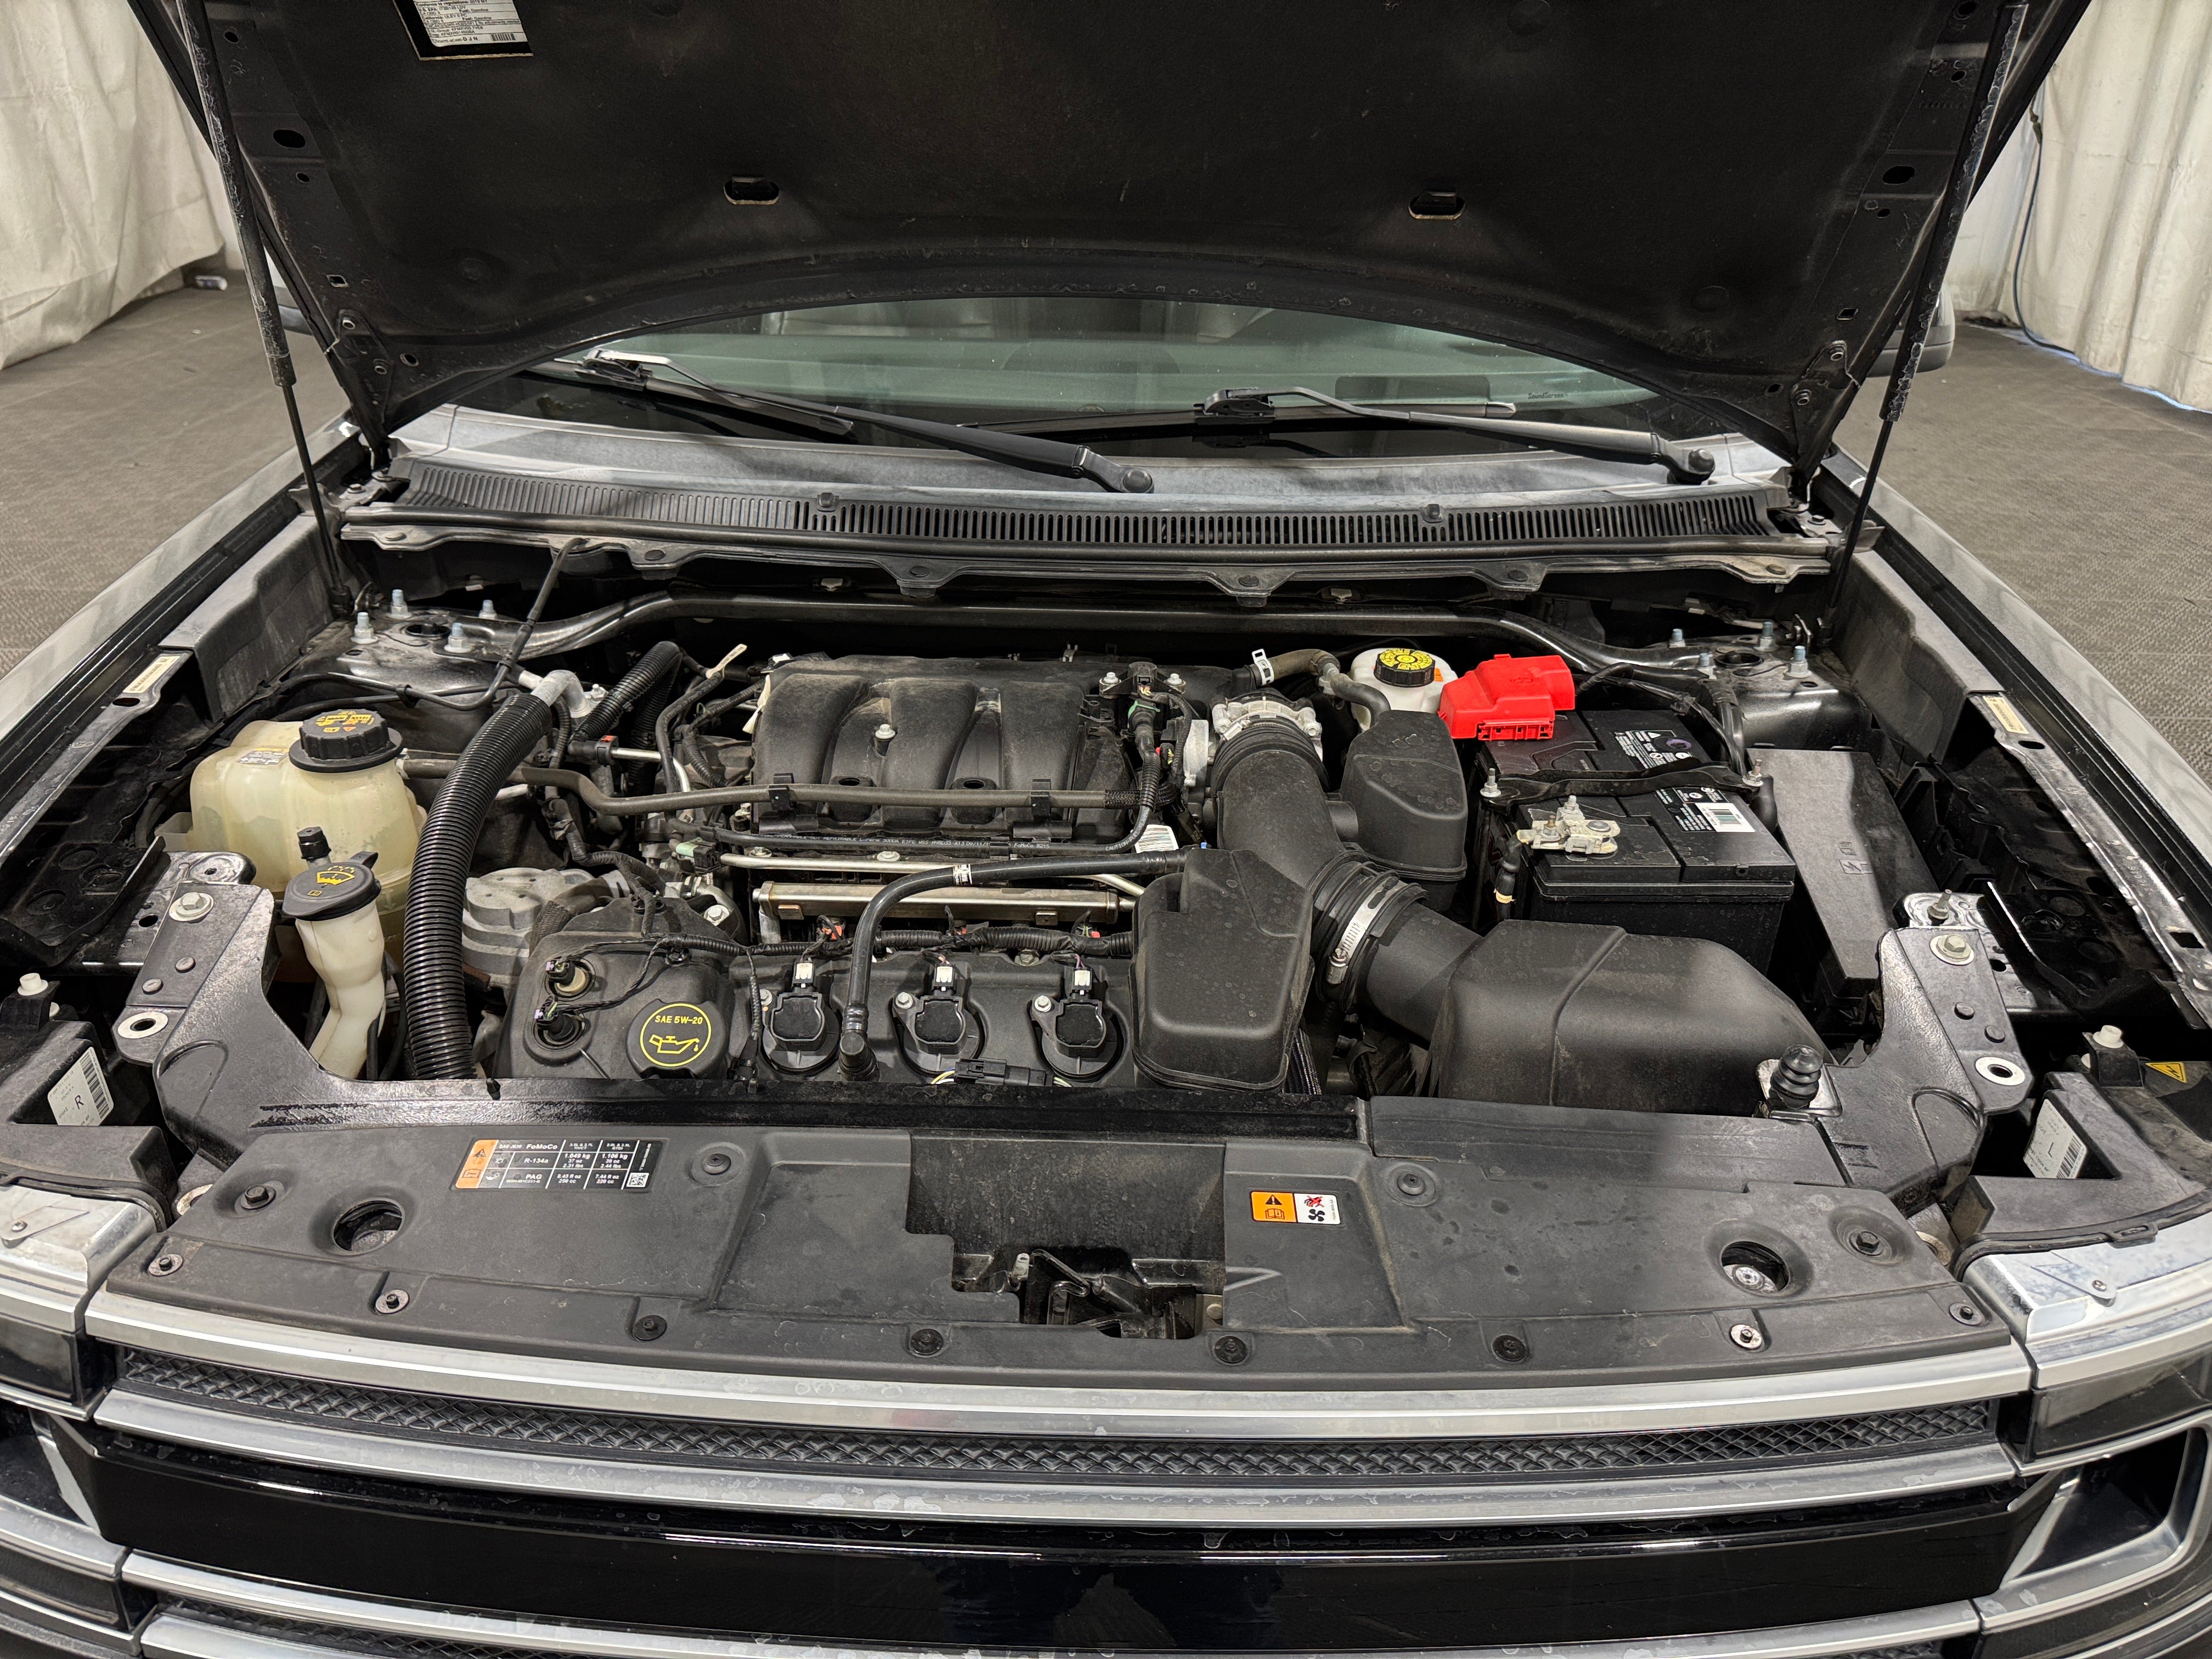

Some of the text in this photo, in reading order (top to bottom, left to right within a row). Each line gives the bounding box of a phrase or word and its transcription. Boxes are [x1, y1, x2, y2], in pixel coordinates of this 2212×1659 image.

[654, 1015, 704, 1025] SAE 5W-20
[75, 1094, 84, 1110] R
